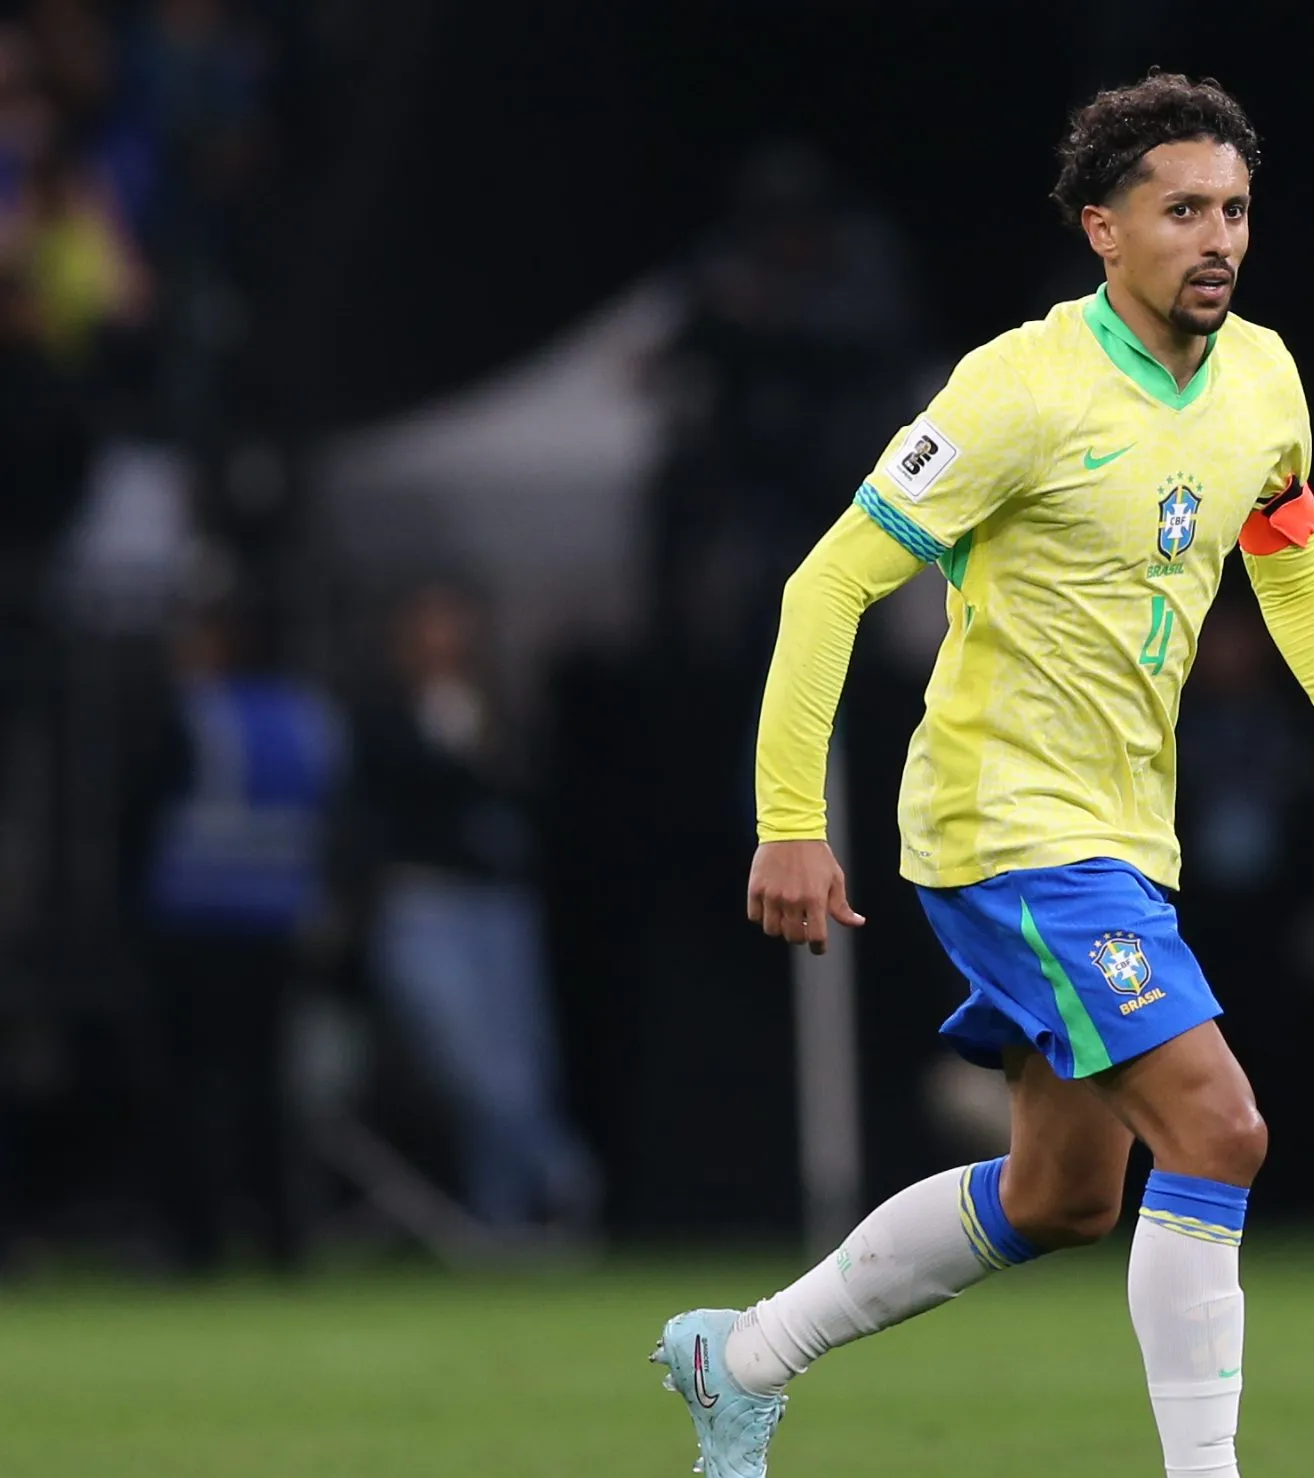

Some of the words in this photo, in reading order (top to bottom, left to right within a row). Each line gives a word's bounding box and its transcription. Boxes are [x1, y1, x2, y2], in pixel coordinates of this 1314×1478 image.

[1170, 516, 1186, 526] CBF
[1147, 562, 1184, 578] BRASIL
[1139, 595, 1174, 675] 4
[1115, 959, 1131, 971] CBF
[1119, 988, 1167, 1016] BRASIL
